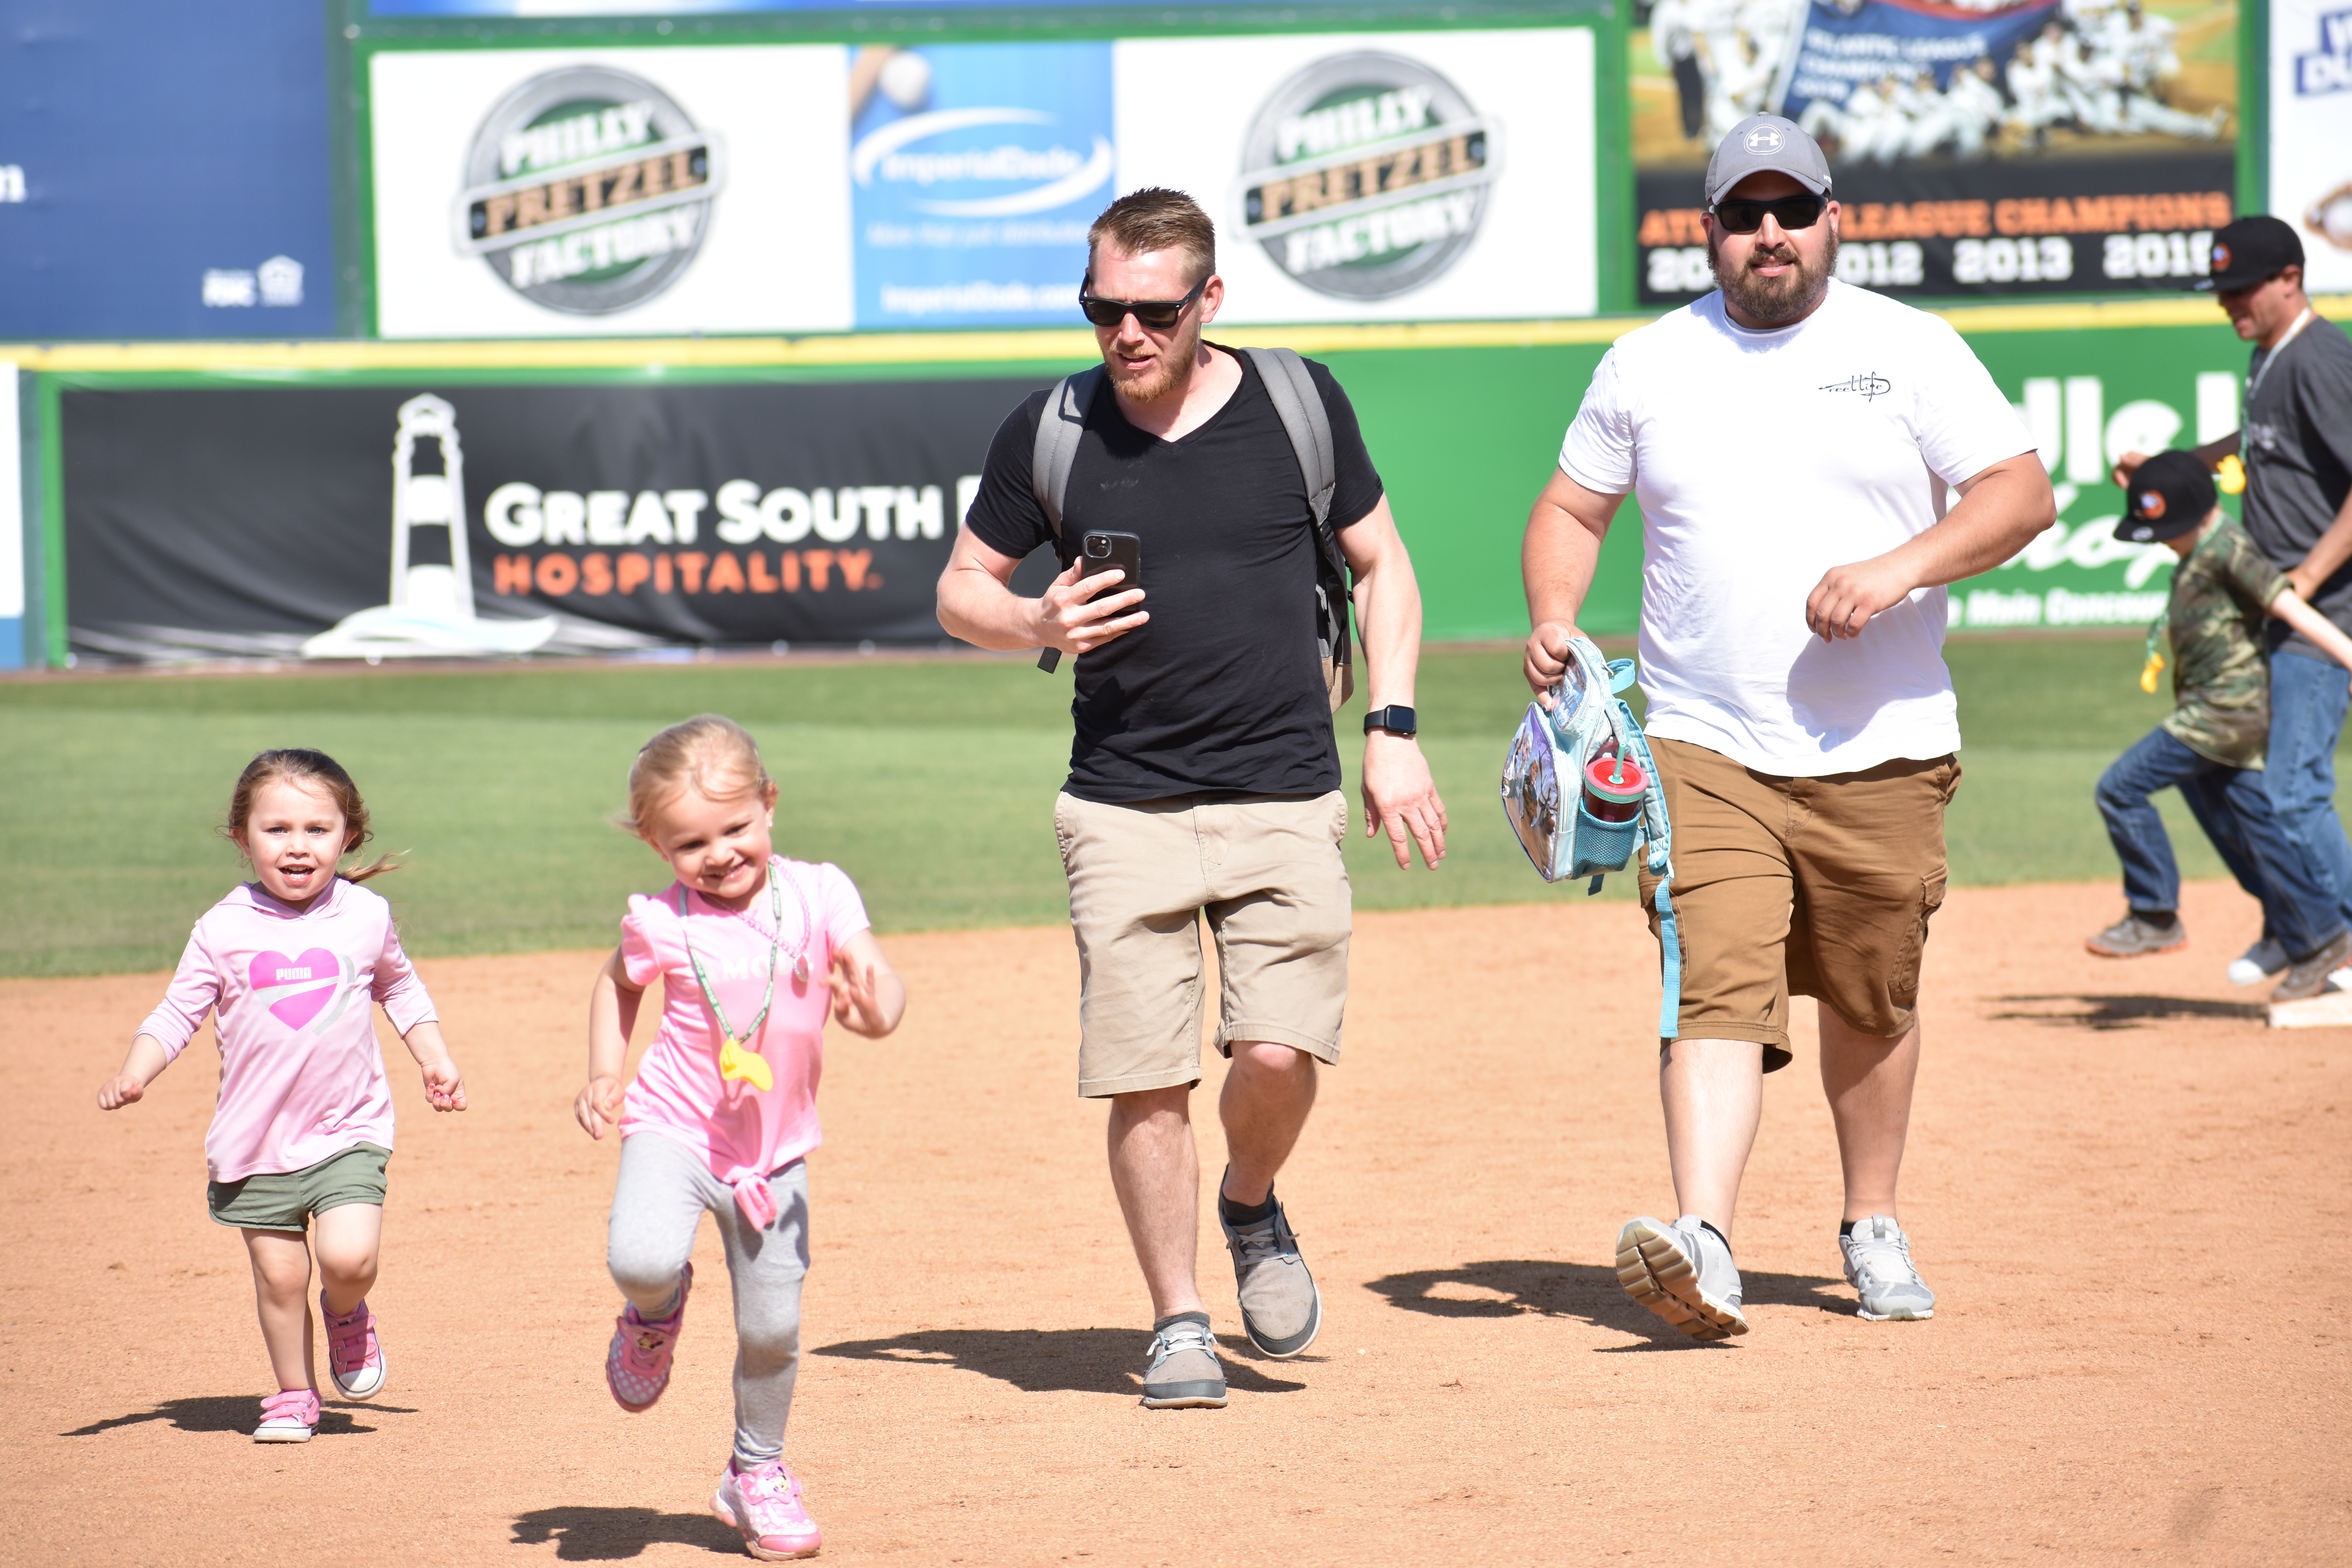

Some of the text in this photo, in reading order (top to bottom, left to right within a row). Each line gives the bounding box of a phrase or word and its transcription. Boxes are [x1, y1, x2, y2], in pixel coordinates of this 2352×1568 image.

[501, 100, 654, 175] PHILLY
[1276, 83, 1433, 160] PHILLY
[485, 151, 706, 236] PRETZEL
[1262, 135, 1485, 222] PRETZEL
[1839, 191, 2232, 240] LEAGUE CHAMPIONS
[510, 205, 700, 289] FACTORY
[1285, 189, 1475, 274] FACTORY
[1953, 237, 2073, 283] 2013
[484, 481, 708, 547] GREAT
[715, 479, 944, 544] SOUTH
[1966, 589, 2041, 628] Main
[276, 967, 312, 980] PUMA
